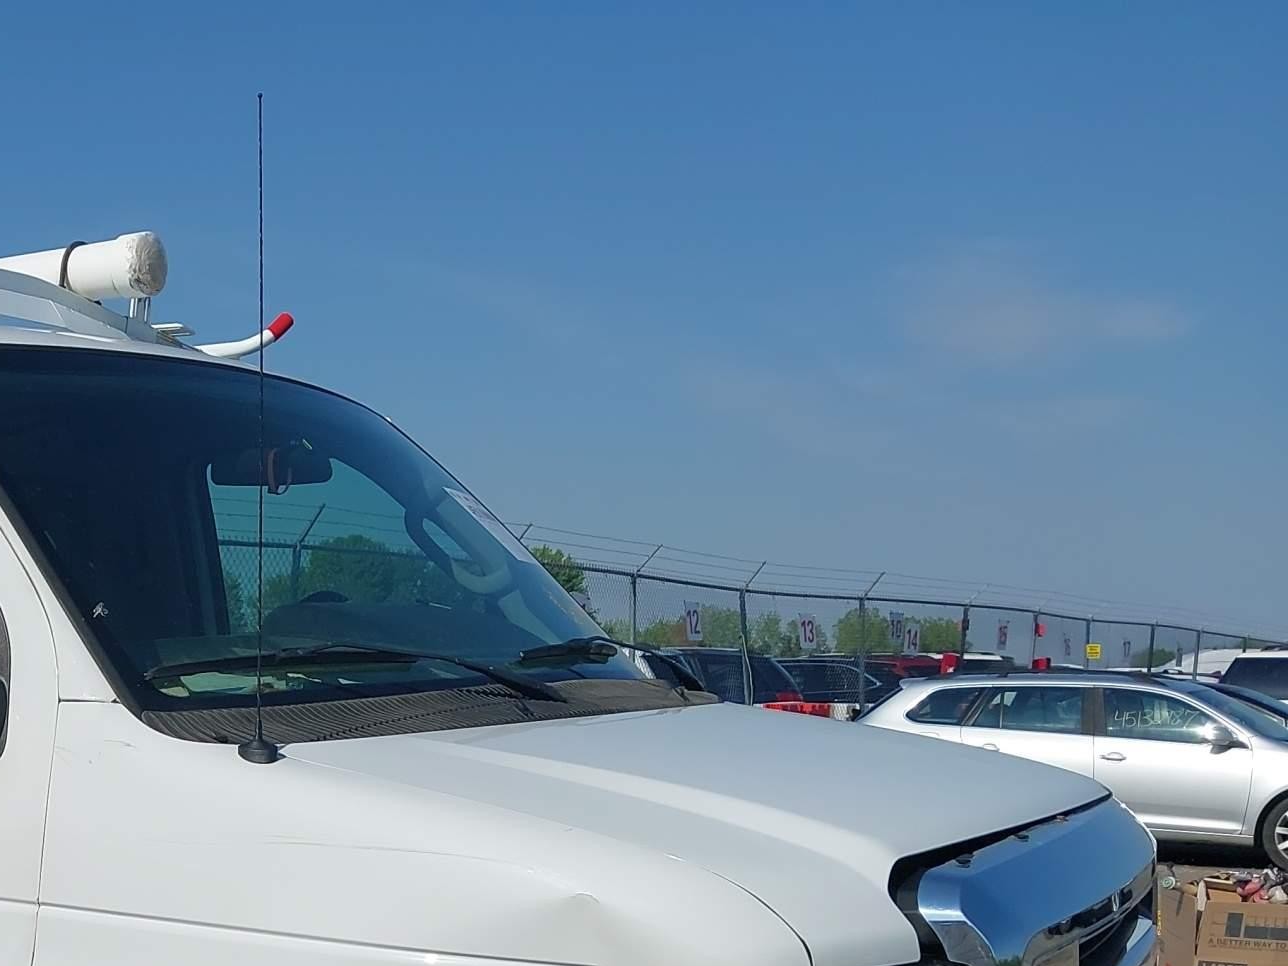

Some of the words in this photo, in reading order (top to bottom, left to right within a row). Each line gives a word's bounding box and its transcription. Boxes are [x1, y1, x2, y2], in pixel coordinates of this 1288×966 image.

[686, 610, 701, 635] 12
[801, 620, 815, 643] 13
[907, 628, 918, 650] 14
